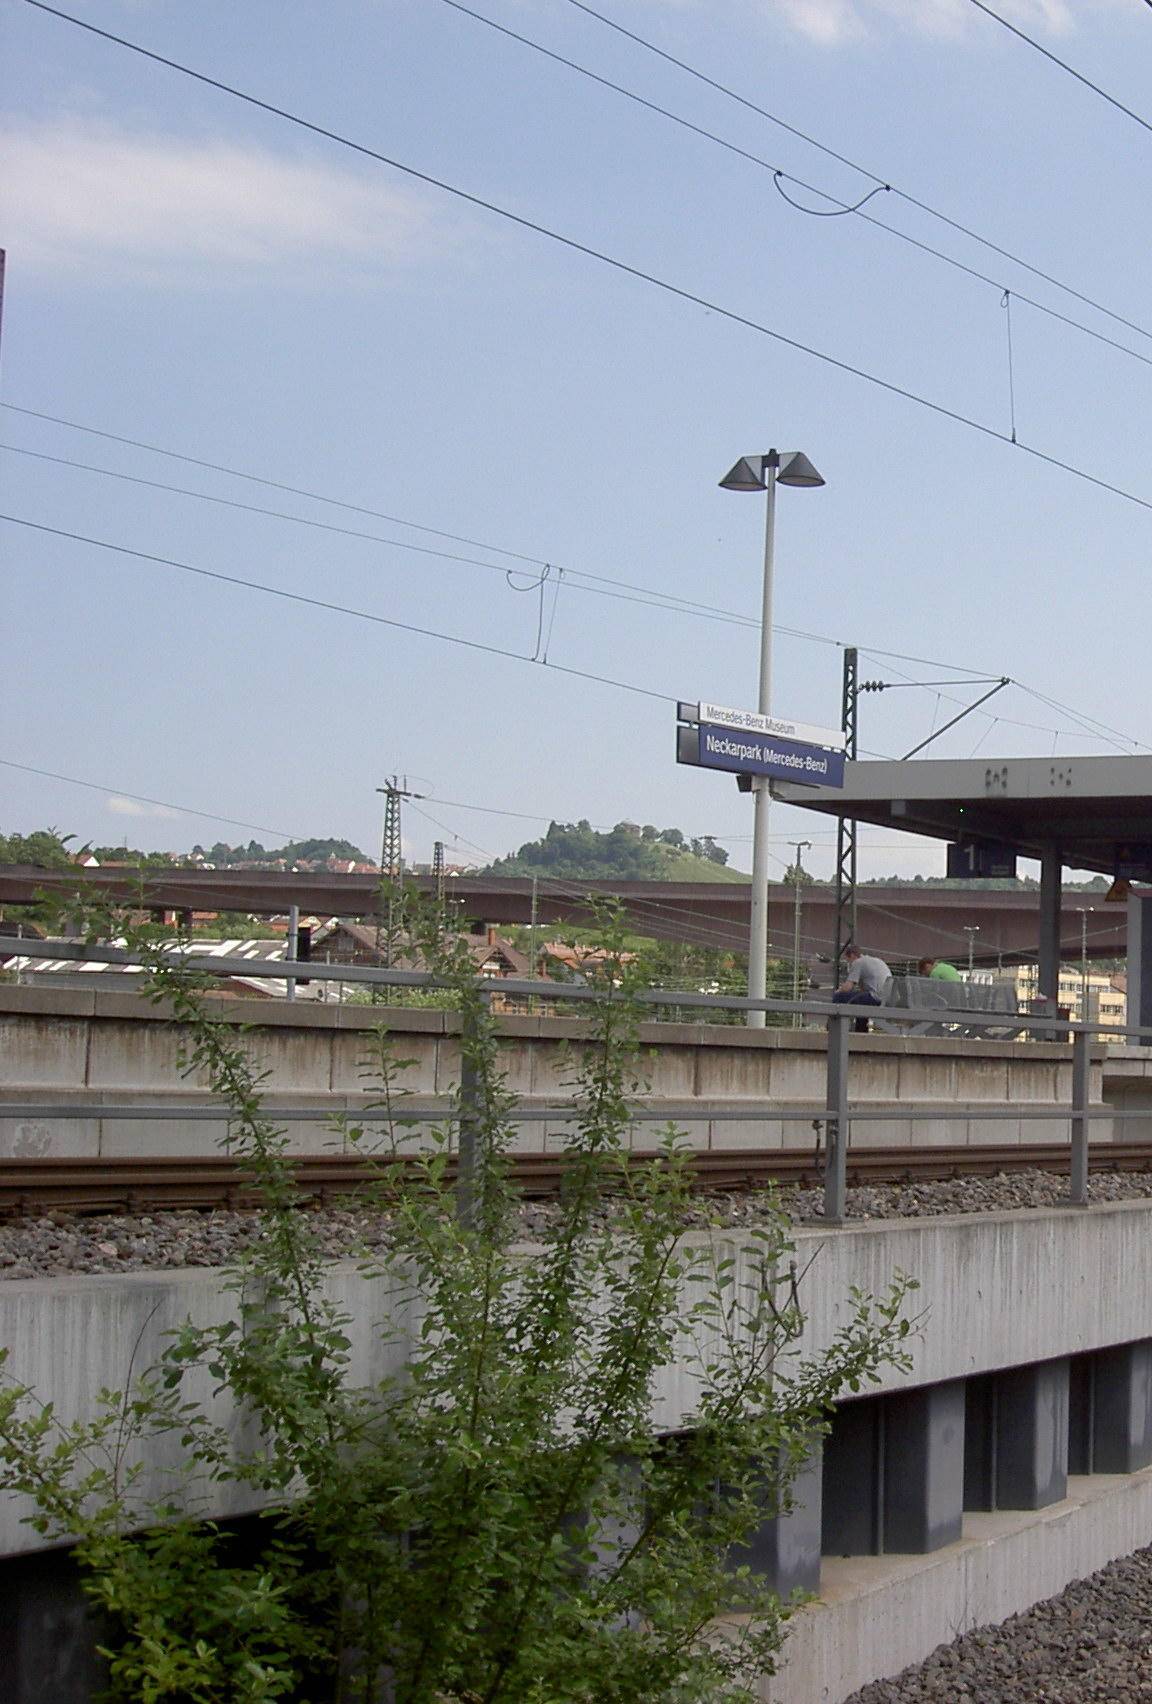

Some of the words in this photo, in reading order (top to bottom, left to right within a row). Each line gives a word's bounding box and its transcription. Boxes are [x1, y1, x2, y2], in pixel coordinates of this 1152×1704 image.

[706, 706, 764, 730] Mercedes-Benz
[765, 718, 796, 735] Museum
[706, 735, 763, 761] Neckarpark
[763, 748, 828, 774] (Mercedes-Benz)
[963, 844, 975, 870] 1
